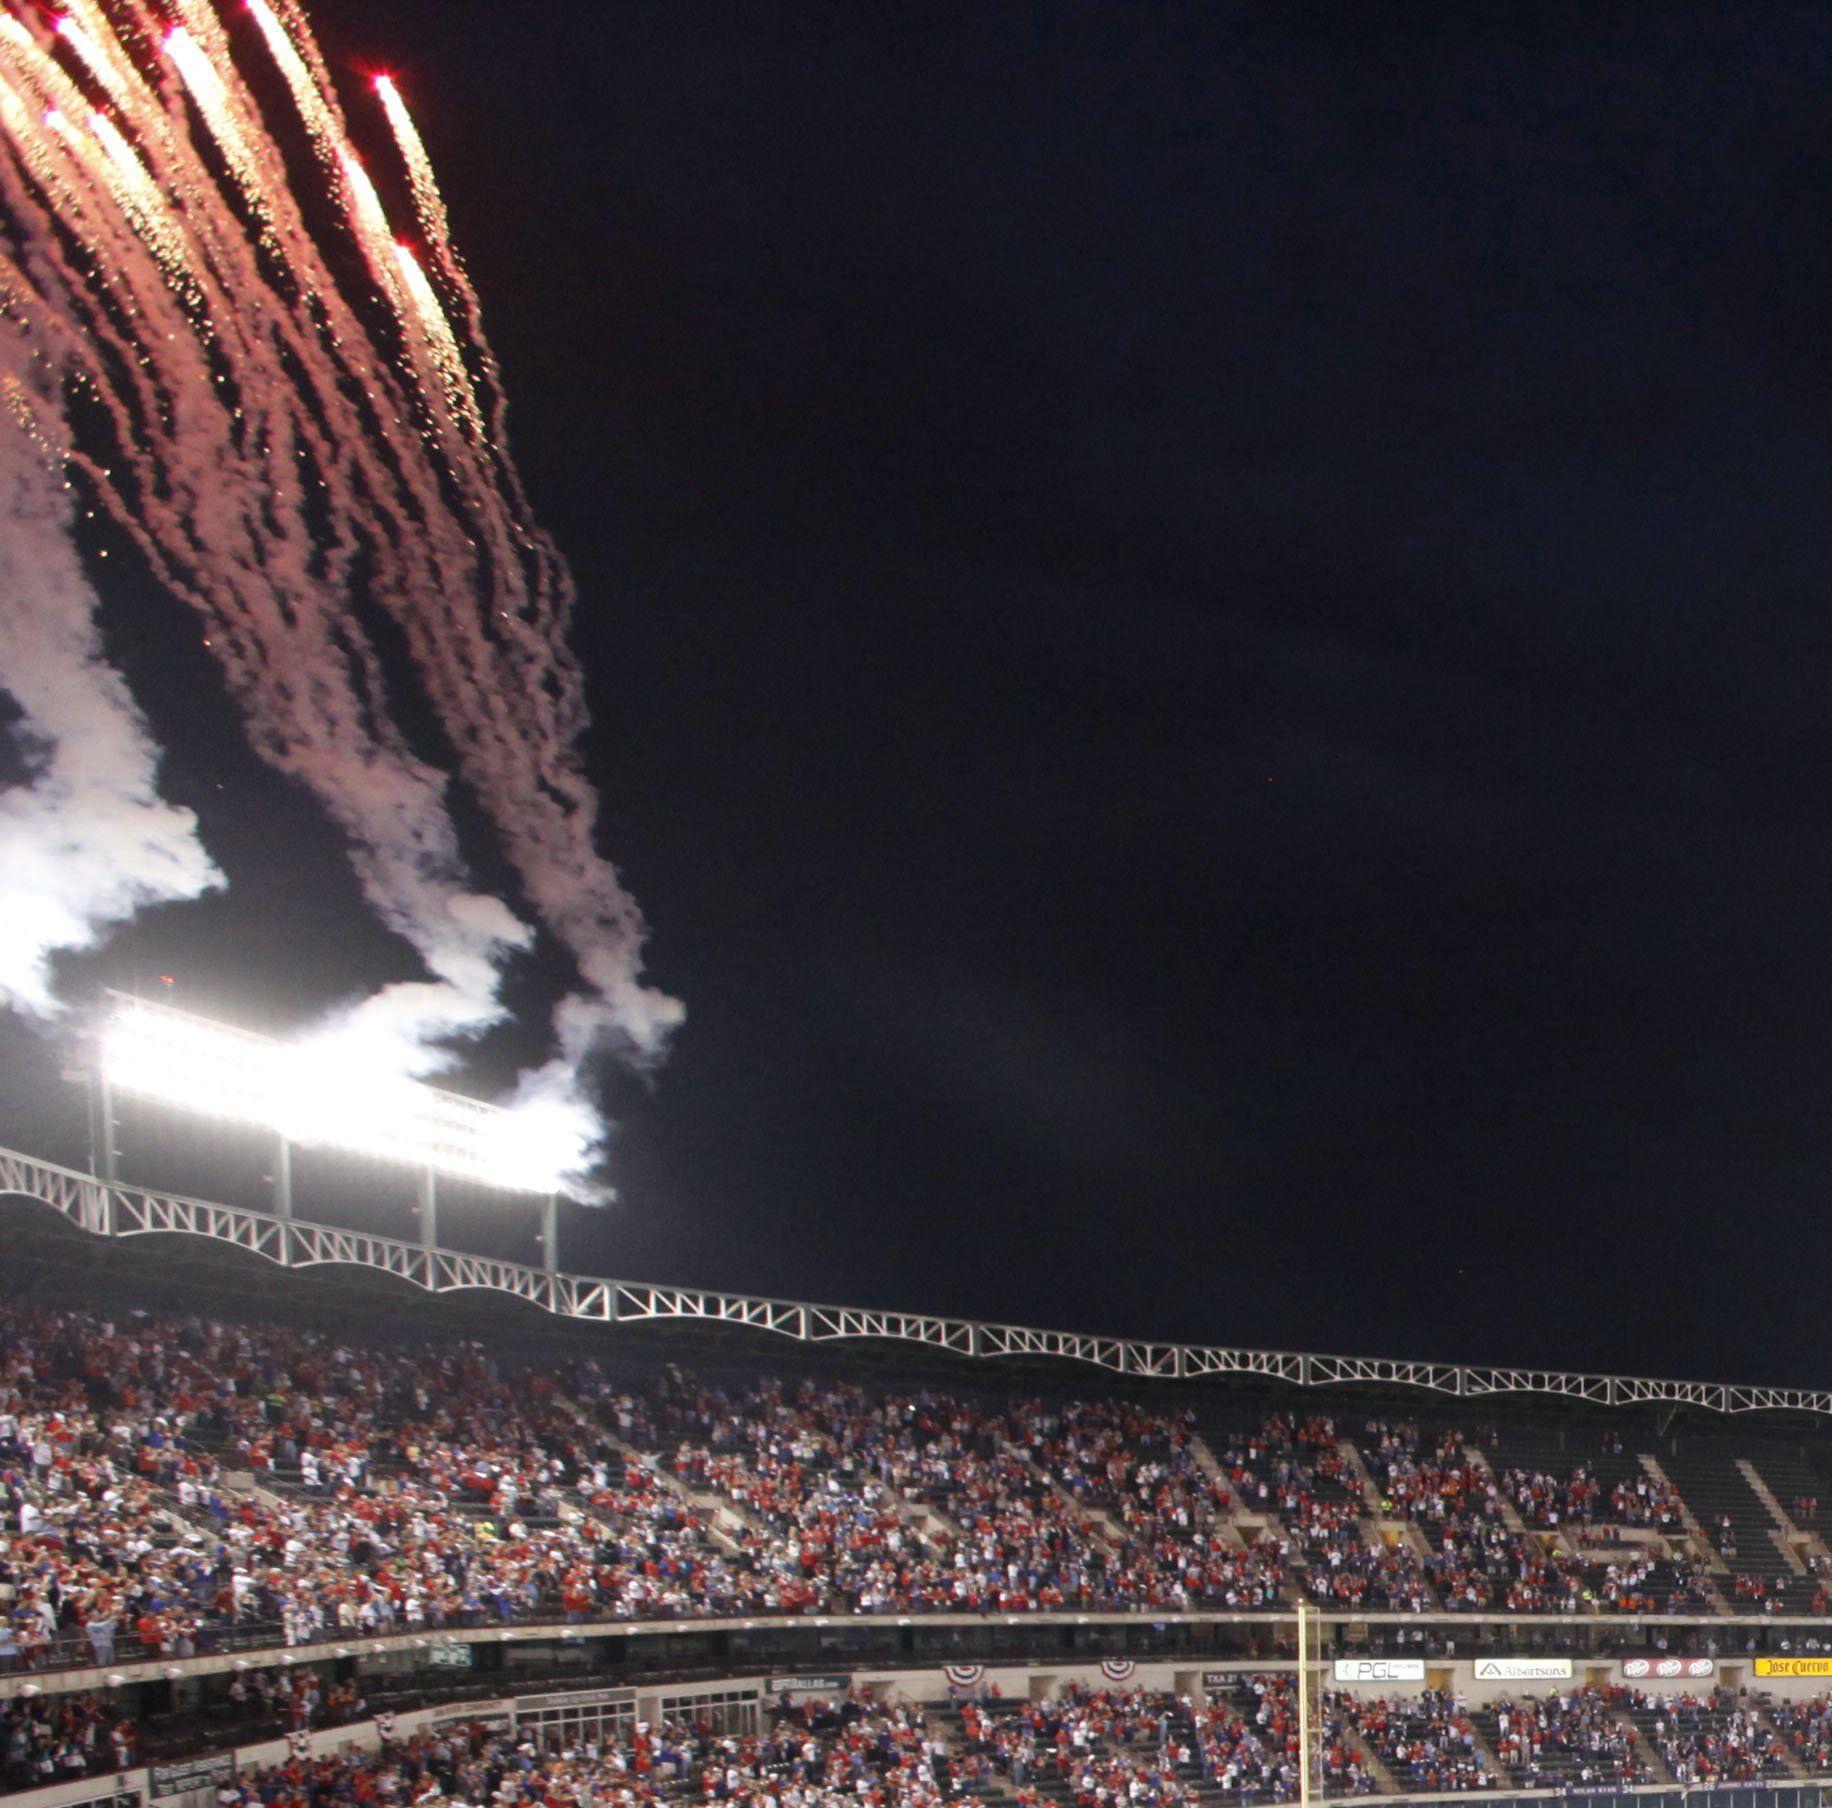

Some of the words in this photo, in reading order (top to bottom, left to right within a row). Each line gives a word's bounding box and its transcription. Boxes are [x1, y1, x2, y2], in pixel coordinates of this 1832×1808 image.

[1504, 1663, 1567, 1677] Albertsons
[1767, 1660, 1790, 1675] Jose
[1792, 1660, 1829, 1675] Cuervo
